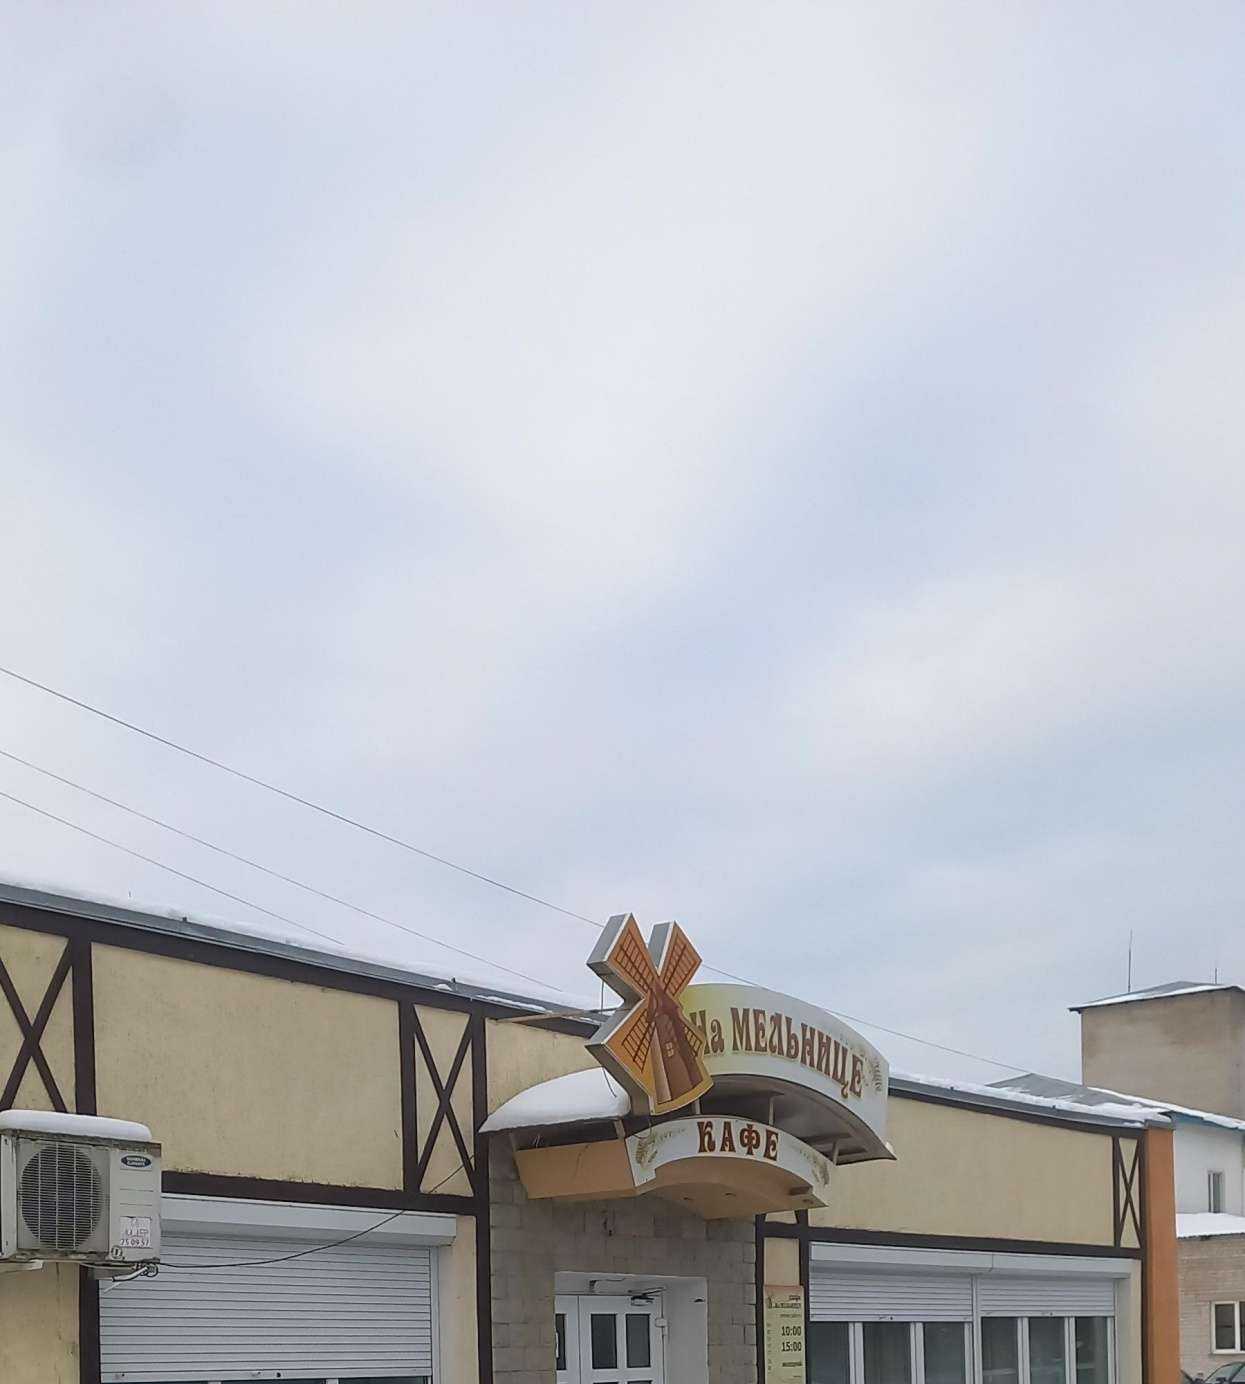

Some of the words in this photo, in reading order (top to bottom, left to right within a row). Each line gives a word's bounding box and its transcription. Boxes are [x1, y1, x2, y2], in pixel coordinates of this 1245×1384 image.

[730, 1007, 864, 1099] МЕЛЬНИЦЕ
[697, 1121, 779, 1161] КАФЕ
[781, 1326, 802, 1337] 10:00
[781, 1341, 802, 1352] 15:00
